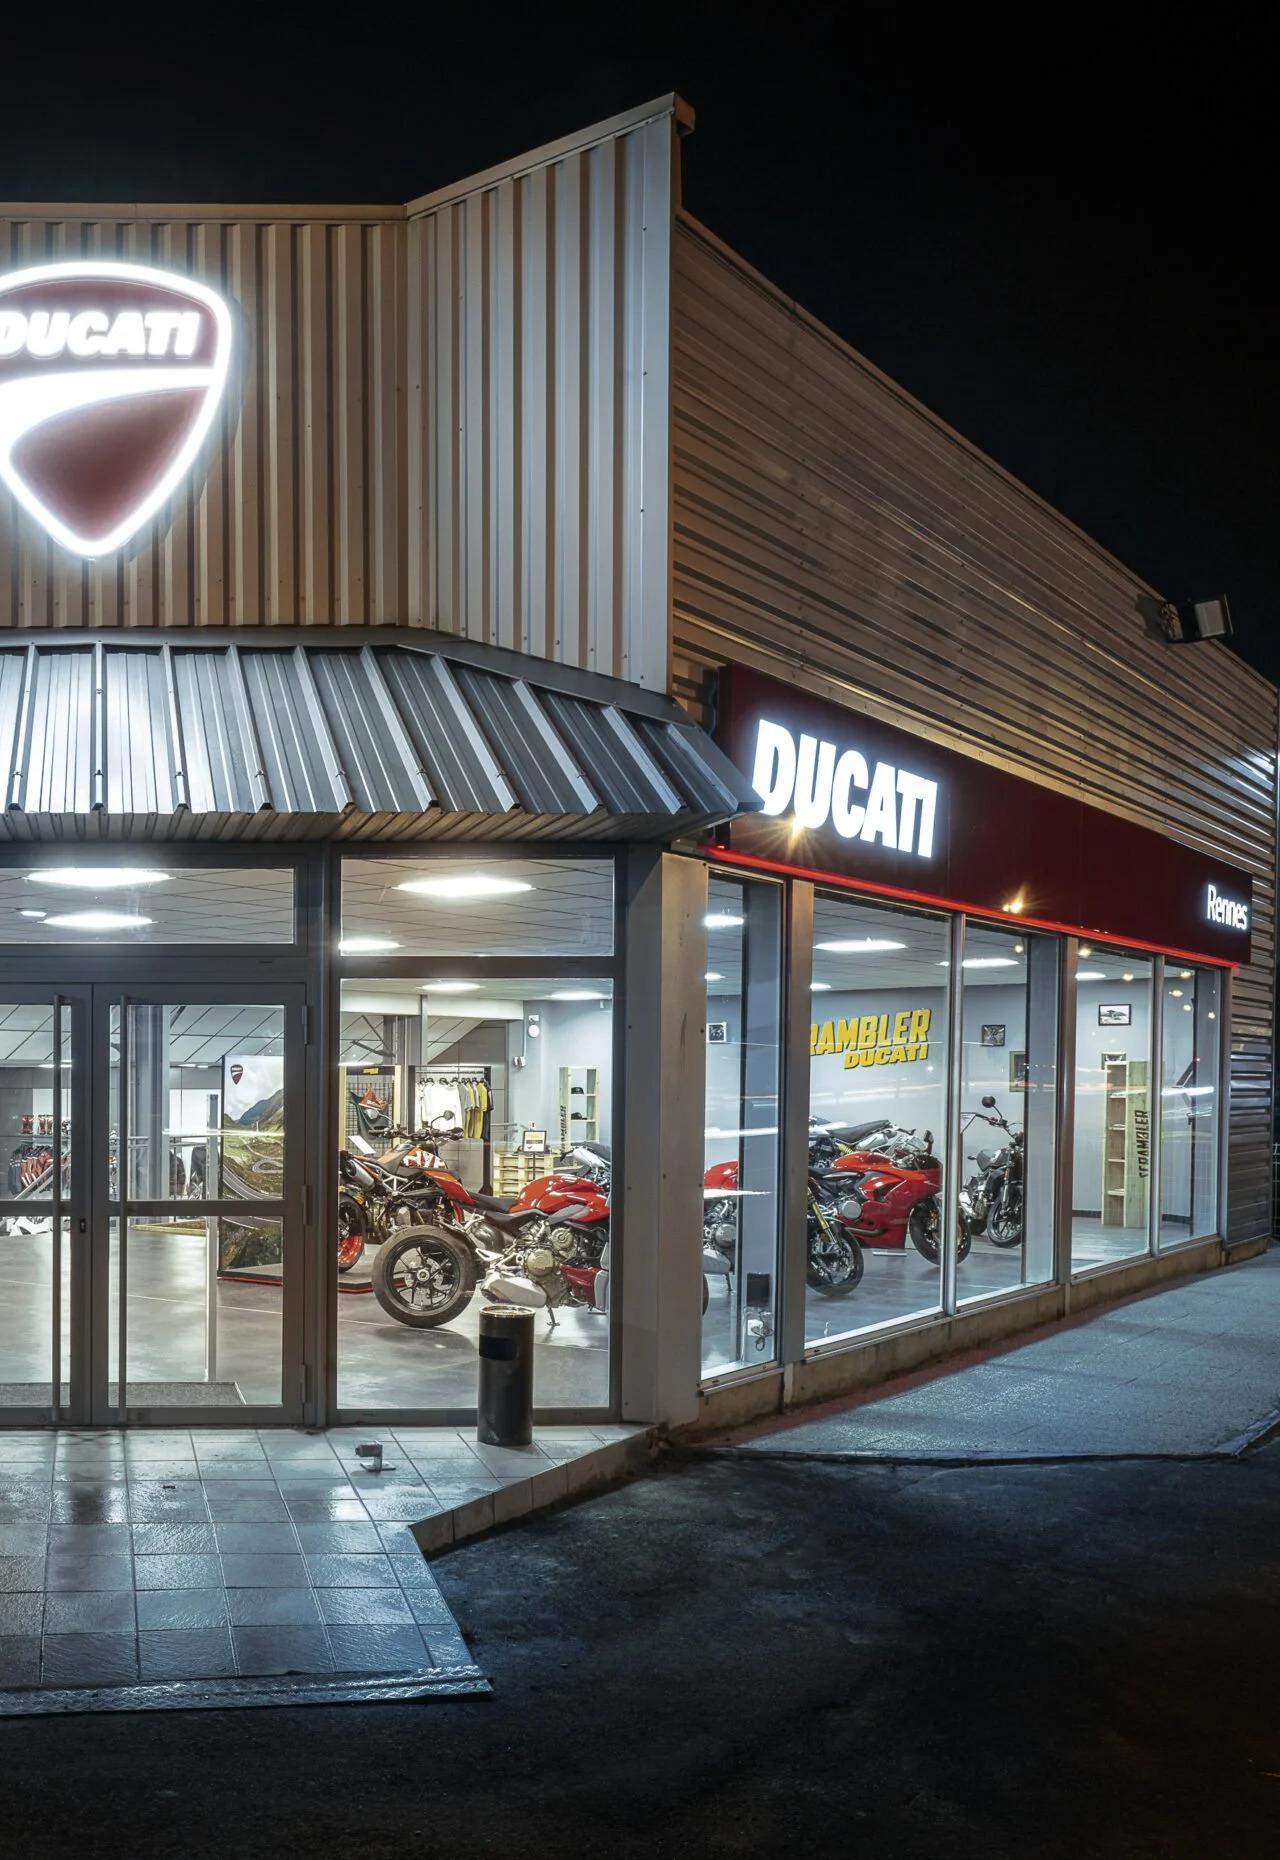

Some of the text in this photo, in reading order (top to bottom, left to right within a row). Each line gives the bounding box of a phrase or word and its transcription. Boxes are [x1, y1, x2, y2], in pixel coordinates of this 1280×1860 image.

[751, 718, 938, 859] DUCATI
[1206, 883, 1249, 931] Rennes
[843, 1042, 928, 1070] DUCATI
[1134, 1109, 1150, 1178] SCRAMBLER
